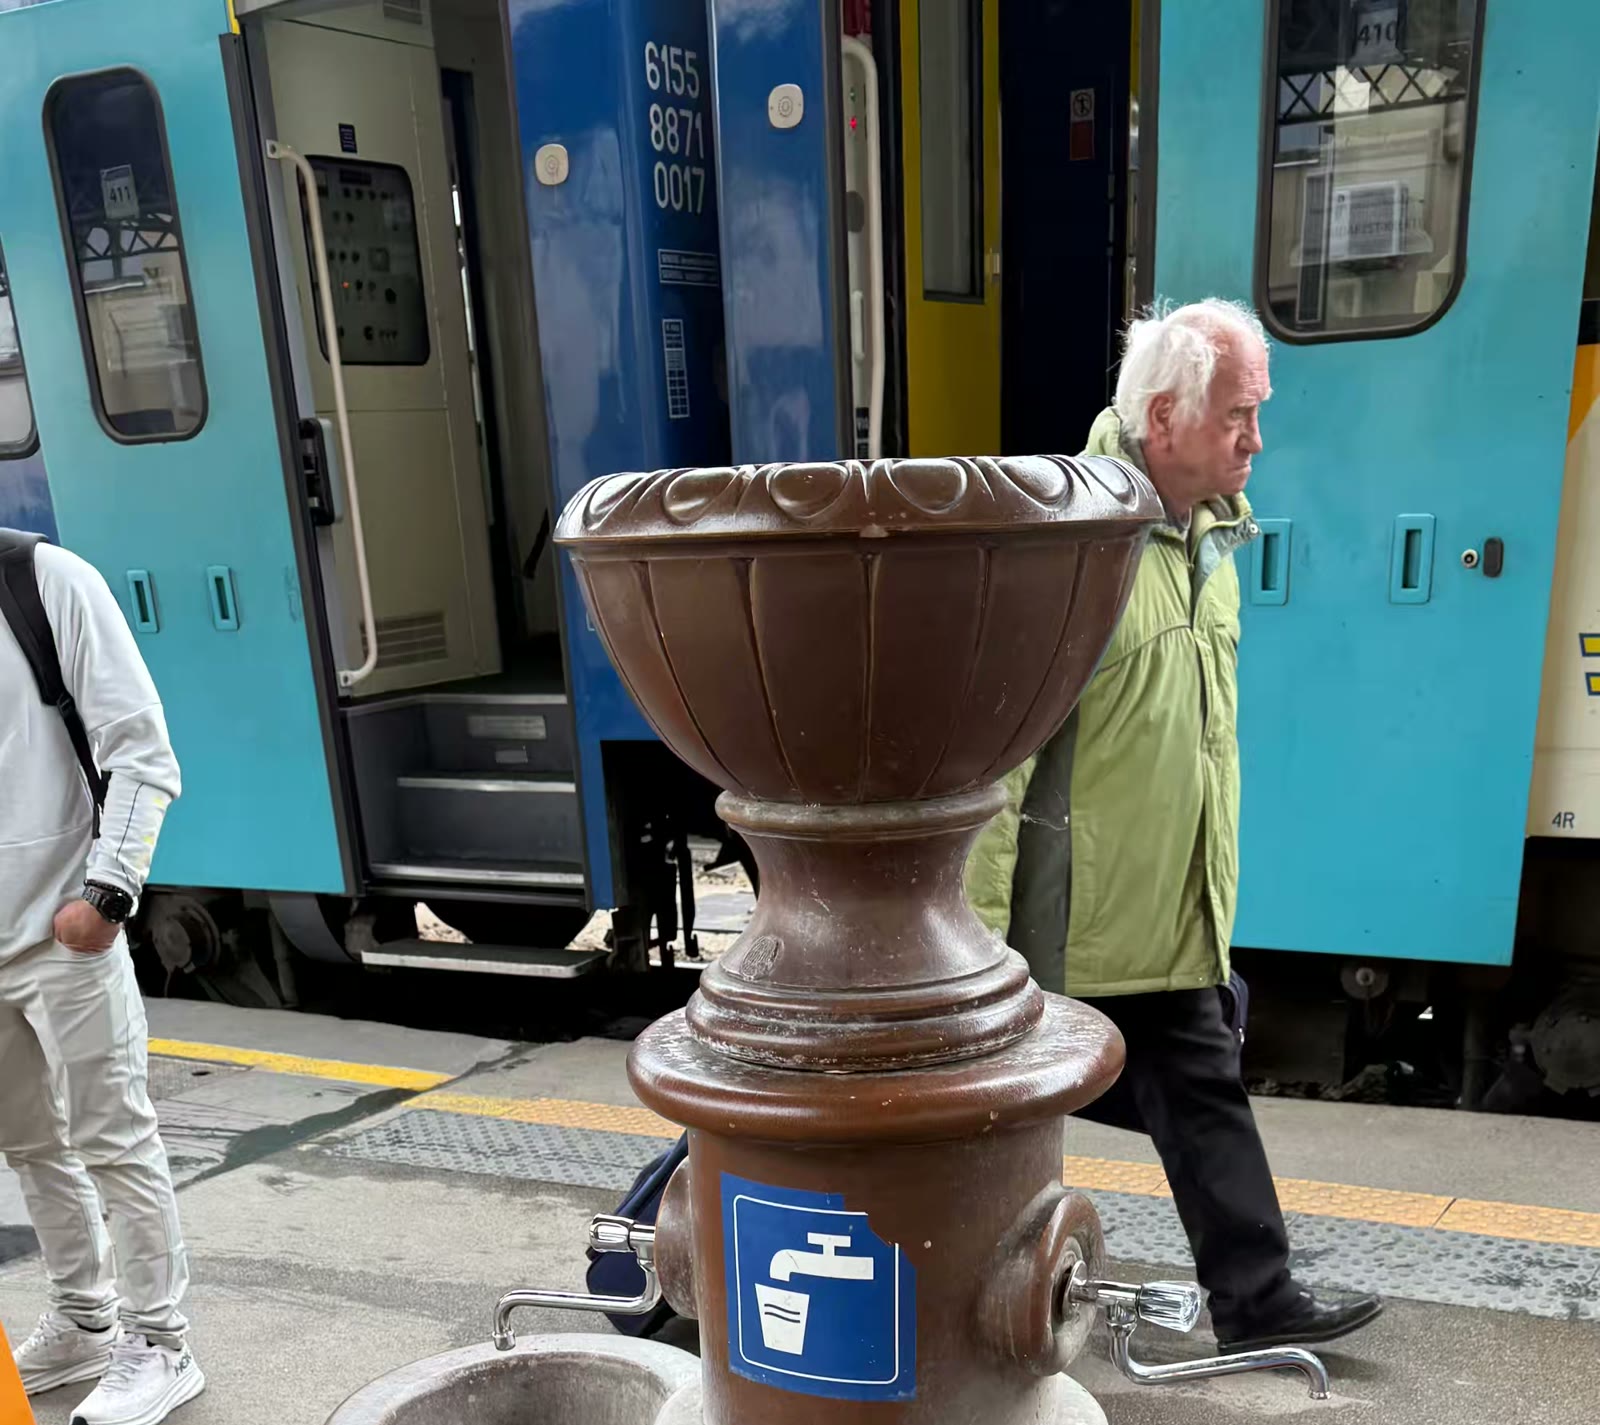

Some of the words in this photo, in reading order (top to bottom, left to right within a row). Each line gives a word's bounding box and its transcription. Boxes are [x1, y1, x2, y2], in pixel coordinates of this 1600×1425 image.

[645, 41, 699, 98] 6155
[650, 103, 704, 159] 8871
[110, 186, 131, 203] 411
[654, 161, 705, 214] 0017
[1552, 811, 1575, 829] 4R
